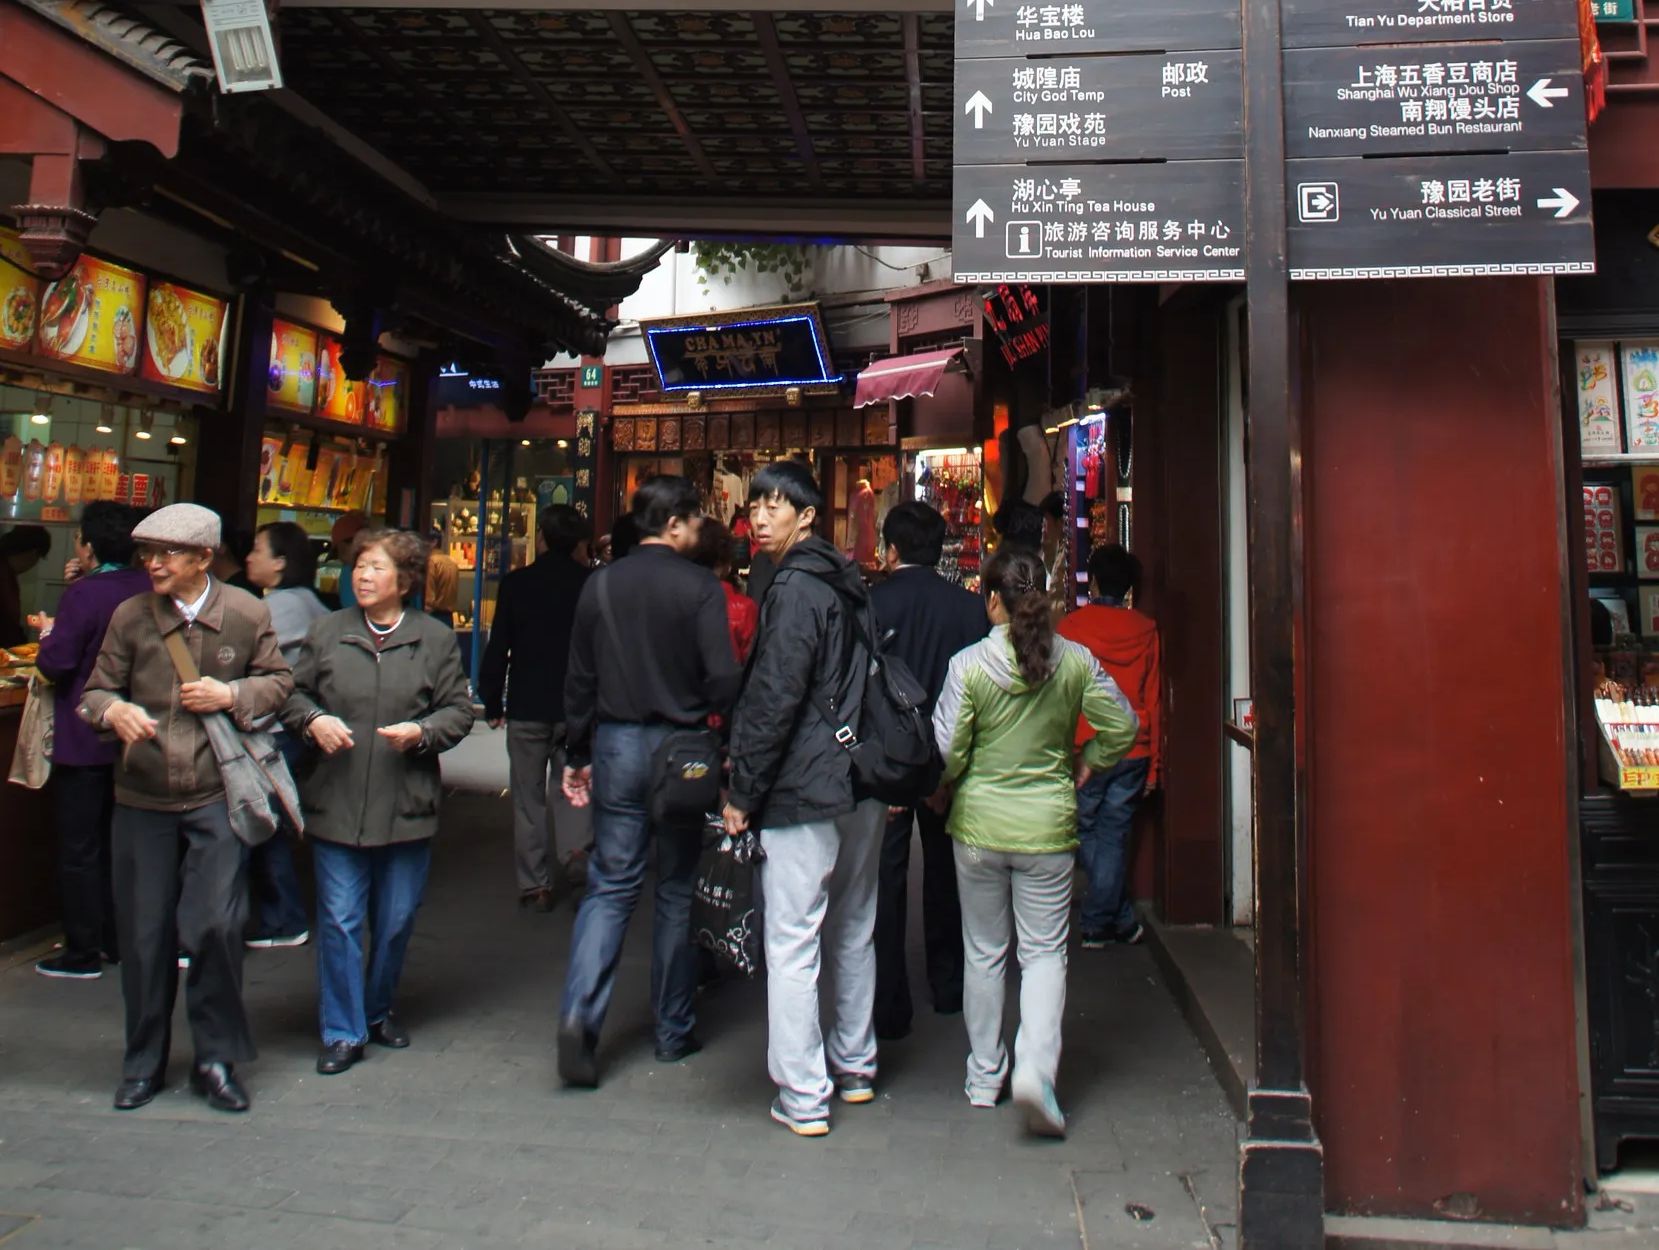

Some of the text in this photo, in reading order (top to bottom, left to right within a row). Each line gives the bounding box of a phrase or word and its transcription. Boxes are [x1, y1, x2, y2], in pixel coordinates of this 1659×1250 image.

[1016, 4, 1084, 28] 华宝楼
[1346, 12, 1514, 27] Tian Yu Department Store
[1016, 29, 1095, 40] Hua Bao Lou
[1012, 67, 1081, 89] 城隍庙
[1162, 61, 1208, 85] 邮政
[1351, 60, 1517, 89] 上海五香豆商店
[1013, 90, 1104, 104] City God Temp
[1162, 87, 1190, 98] Post
[1337, 87, 1394, 101] Shanghai
[1398, 87, 1417, 97] Wu
[1420, 86, 1455, 98] Xiang
[1487, 84, 1520, 95] Shop
[1400, 97, 1519, 121] 南翔馒头店
[1012, 113, 1106, 136] 豫园戏苑
[1309, 121, 1522, 140] Nanxiang Steamed Bun Restaurant
[1014, 136, 1106, 147] Yu Yuan Stage
[1012, 178, 1081, 201] 湖心亭
[1421, 178, 1520, 205] 豫园老街
[1012, 201, 1155, 214] Hu Xin Ting Tea House
[1370, 205, 1522, 220] Yu Yuan Classical Street
[1044, 220, 1230, 242] 旅游咨询服务中心
[1045, 246, 1240, 258] Tourist Information Service Center
[586, 368, 597, 380] 64
